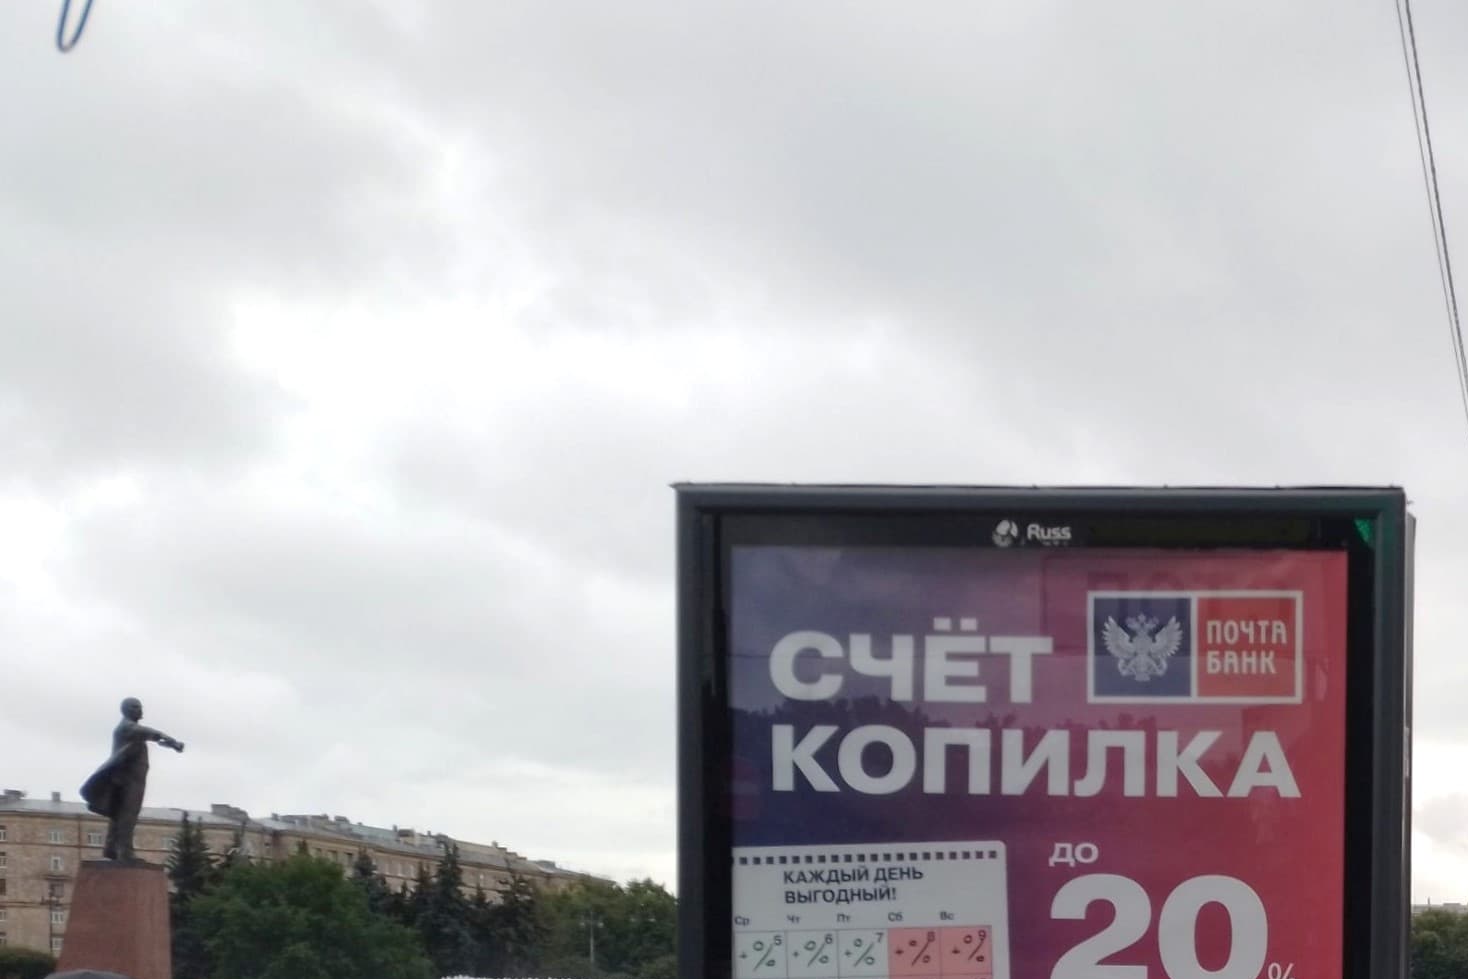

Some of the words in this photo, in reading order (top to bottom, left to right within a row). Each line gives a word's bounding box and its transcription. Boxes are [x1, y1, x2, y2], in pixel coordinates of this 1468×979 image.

[1027, 523, 1071, 540] Russ
[1206, 619, 1287, 646] ПОЧТА
[768, 617, 1054, 704] СЧЁТ
[1206, 650, 1277, 676] БАНК
[771, 724, 1302, 799] КОПИЛКА
[783, 867, 869, 885] КАЖДЫЙ
[873, 867, 924, 883] ДЕНЬ
[784, 885, 897, 904] ВЫГОДНЫЙ!
[734, 915, 750, 927] Ср
[787, 914, 800, 924] Чт
[837, 913, 850, 923] Пт
[888, 911, 903, 922] Сб
[940, 911, 955, 921] Вс
[774, 936, 781, 945] 5
[825, 934, 832, 944] 6
[876, 933, 884, 943] 7
[978, 930, 986, 940] 9
